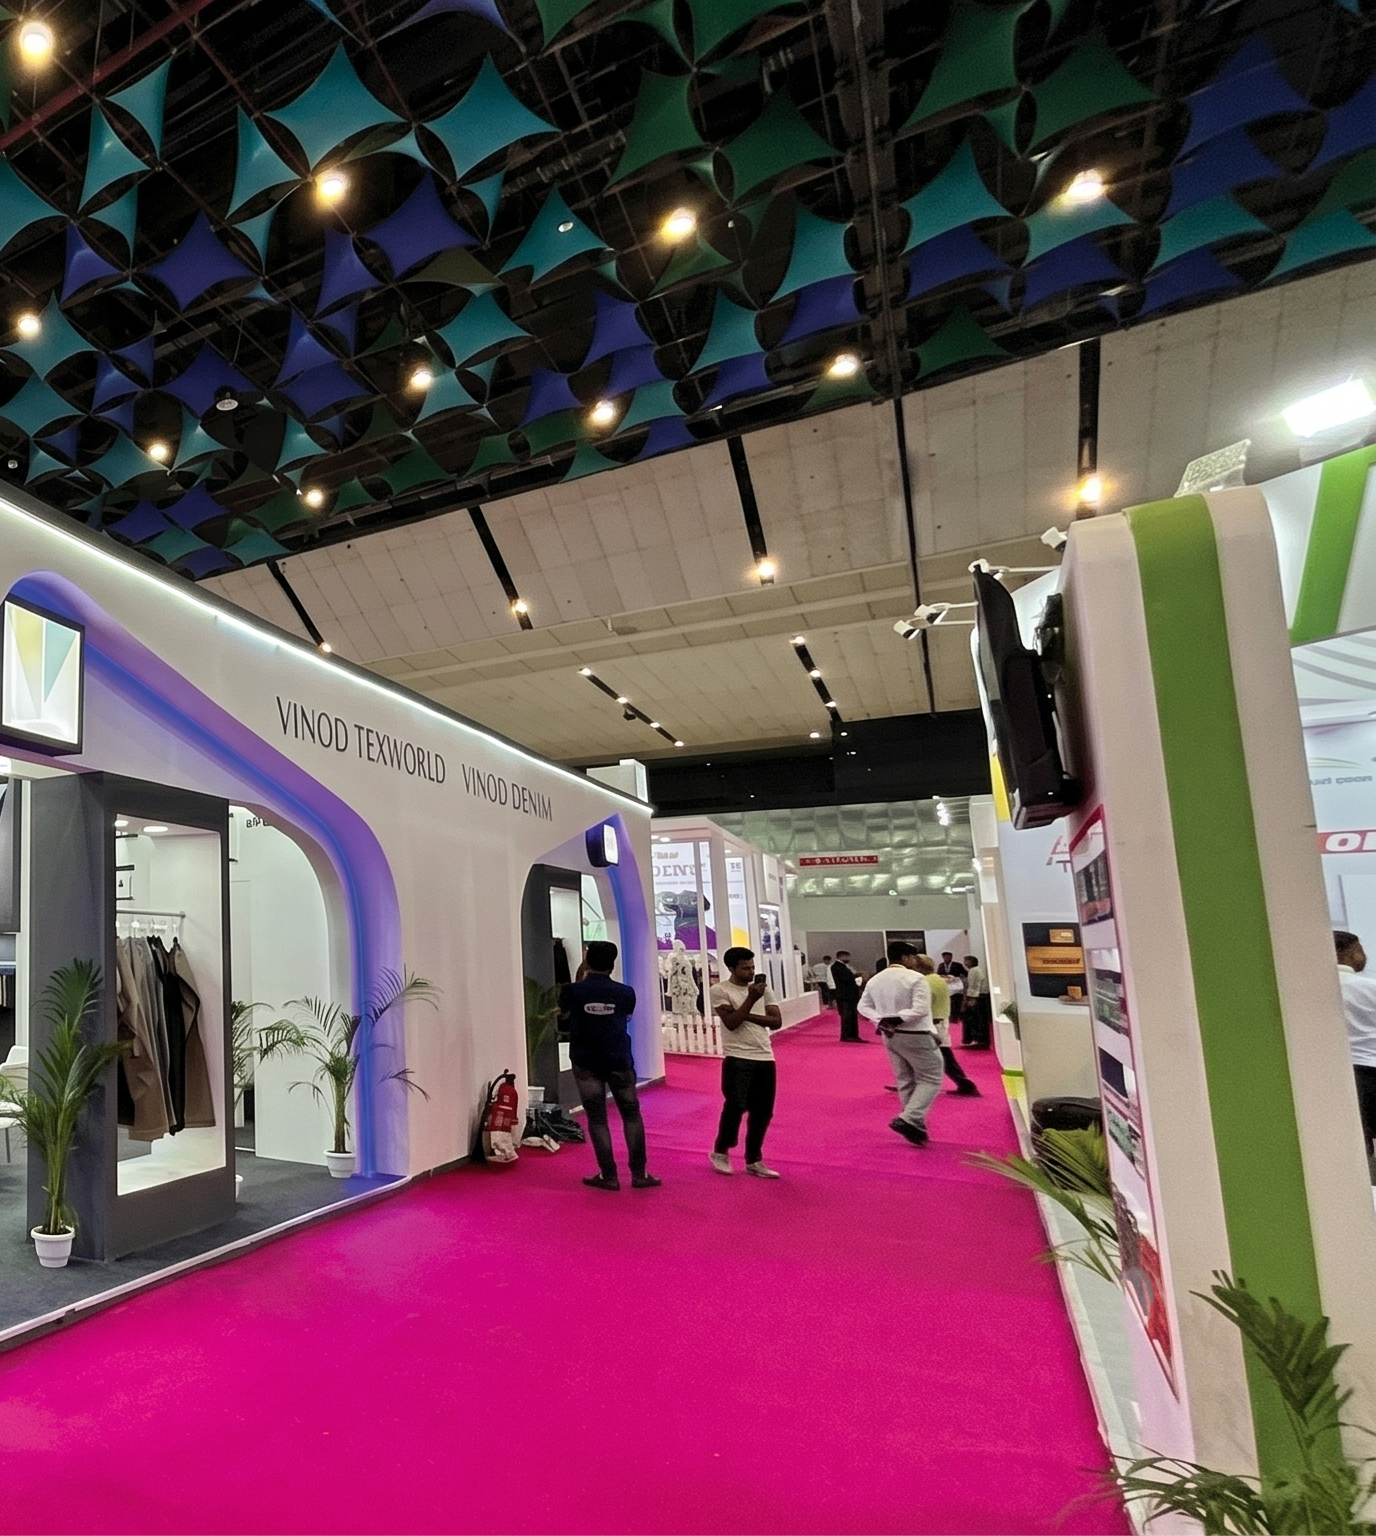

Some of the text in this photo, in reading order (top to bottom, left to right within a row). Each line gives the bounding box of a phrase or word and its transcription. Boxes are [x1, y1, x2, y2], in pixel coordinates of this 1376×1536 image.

[276, 696, 553, 822] VINOD TEXWORLD VINOD DENIM
